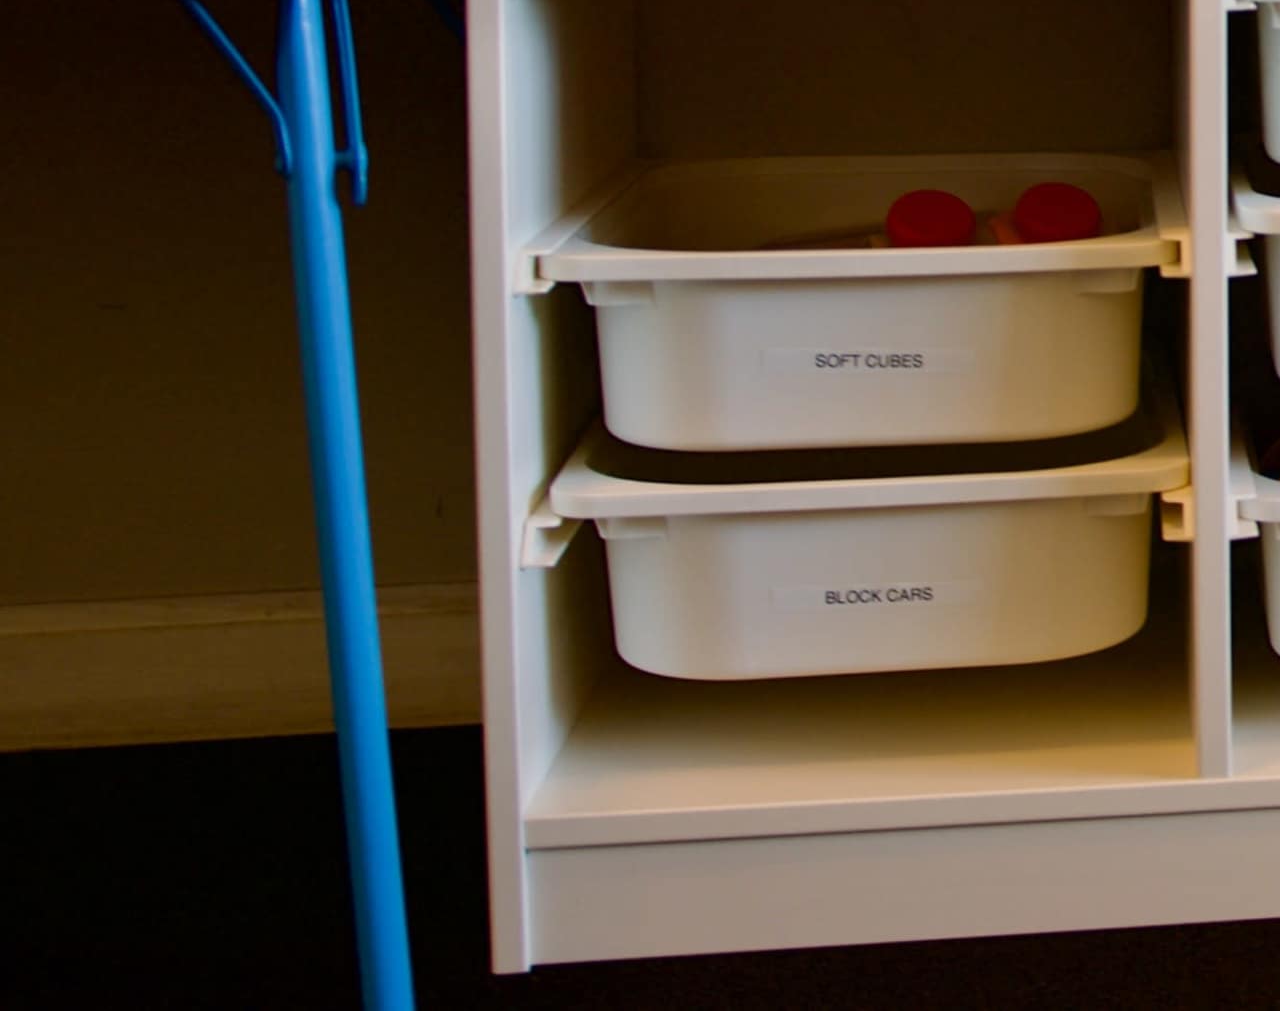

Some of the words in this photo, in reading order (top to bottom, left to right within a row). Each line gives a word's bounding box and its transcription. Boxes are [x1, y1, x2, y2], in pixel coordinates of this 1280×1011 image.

[815, 354, 860, 368] SOFT
[865, 354, 923, 368] CUBES
[825, 590, 882, 605] BLOCK
[886, 587, 934, 603] CARS
